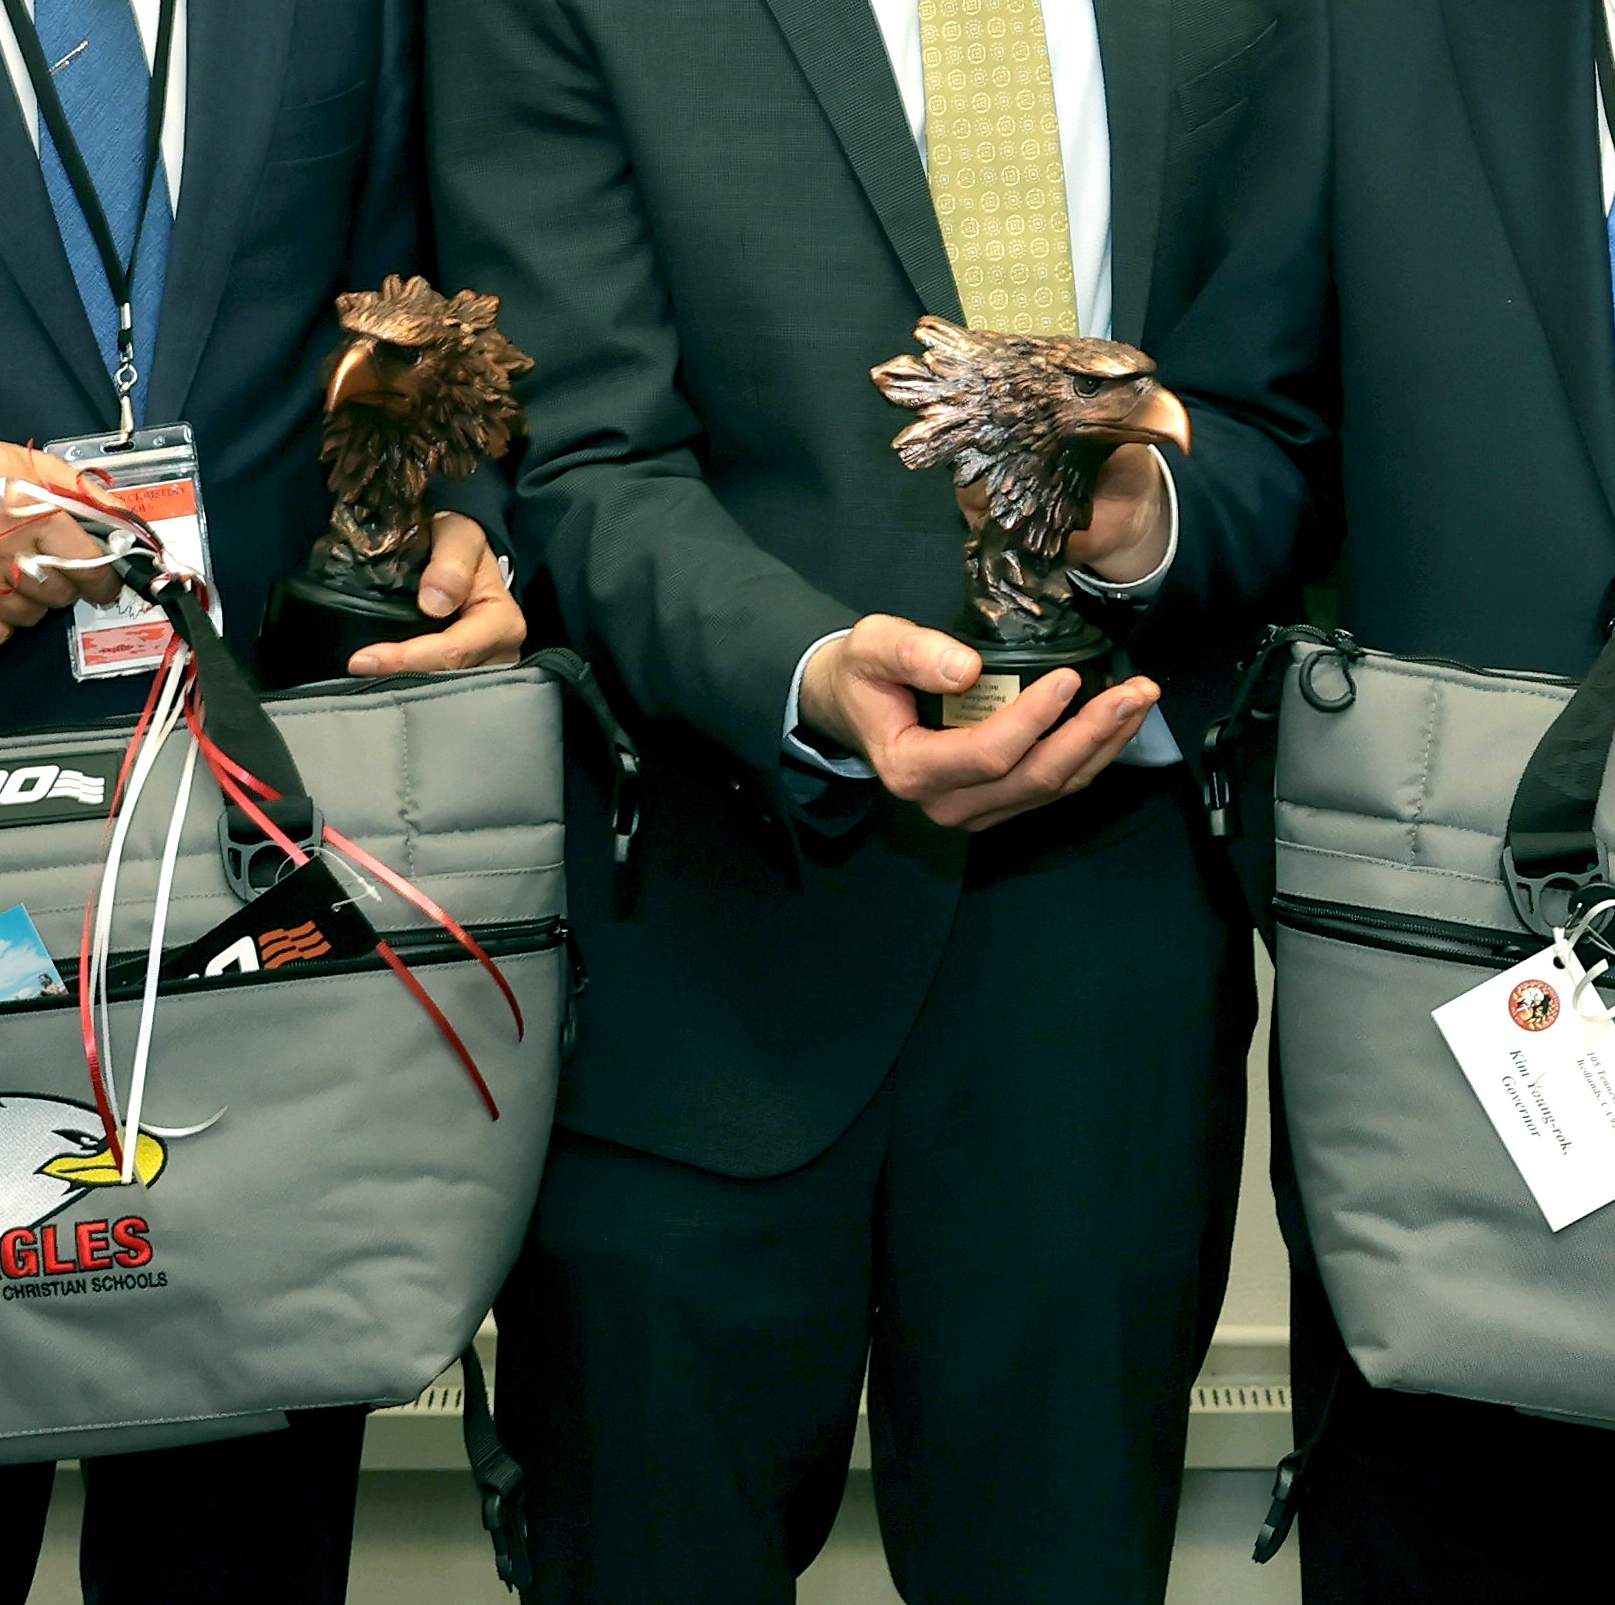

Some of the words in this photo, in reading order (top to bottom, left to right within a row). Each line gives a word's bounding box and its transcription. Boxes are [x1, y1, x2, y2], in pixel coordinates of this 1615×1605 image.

[1586, 1051, 1602, 1067] 105
[1501, 1076, 1541, 1137] Governor
[1509, 1050, 1530, 1077] Kim
[1527, 1077, 1573, 1156] Young-rok,
[2, 1277, 87, 1301] CHRISTIAN
[92, 1270, 169, 1293] SCHOOLS
